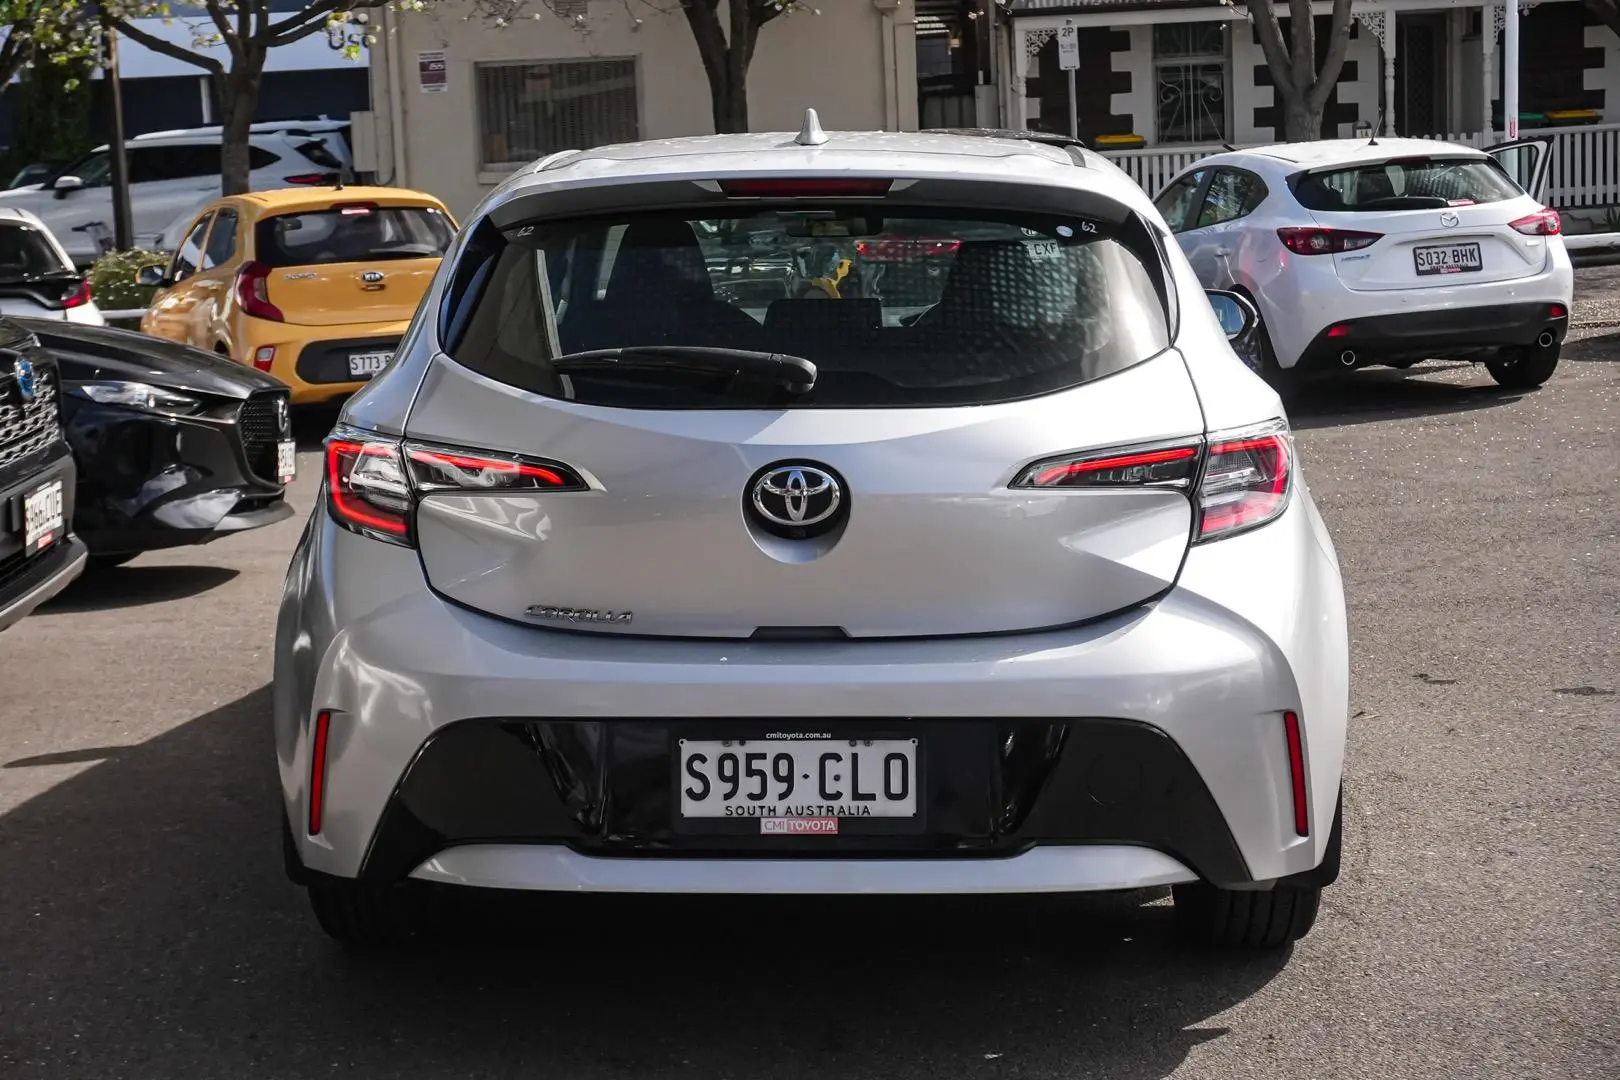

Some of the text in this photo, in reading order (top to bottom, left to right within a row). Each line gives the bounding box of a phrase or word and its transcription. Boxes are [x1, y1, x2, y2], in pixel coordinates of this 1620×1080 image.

[1062, 27, 1074, 37] 2P
[1081, 221, 1099, 234] 62
[524, 604, 632, 624] COROLLA
[765, 732, 831, 740] cmitoyota.com.au
[725, 805, 871, 816] SOUTH AUSTRALIA
[764, 820, 836, 831] CMI TOYOTA
